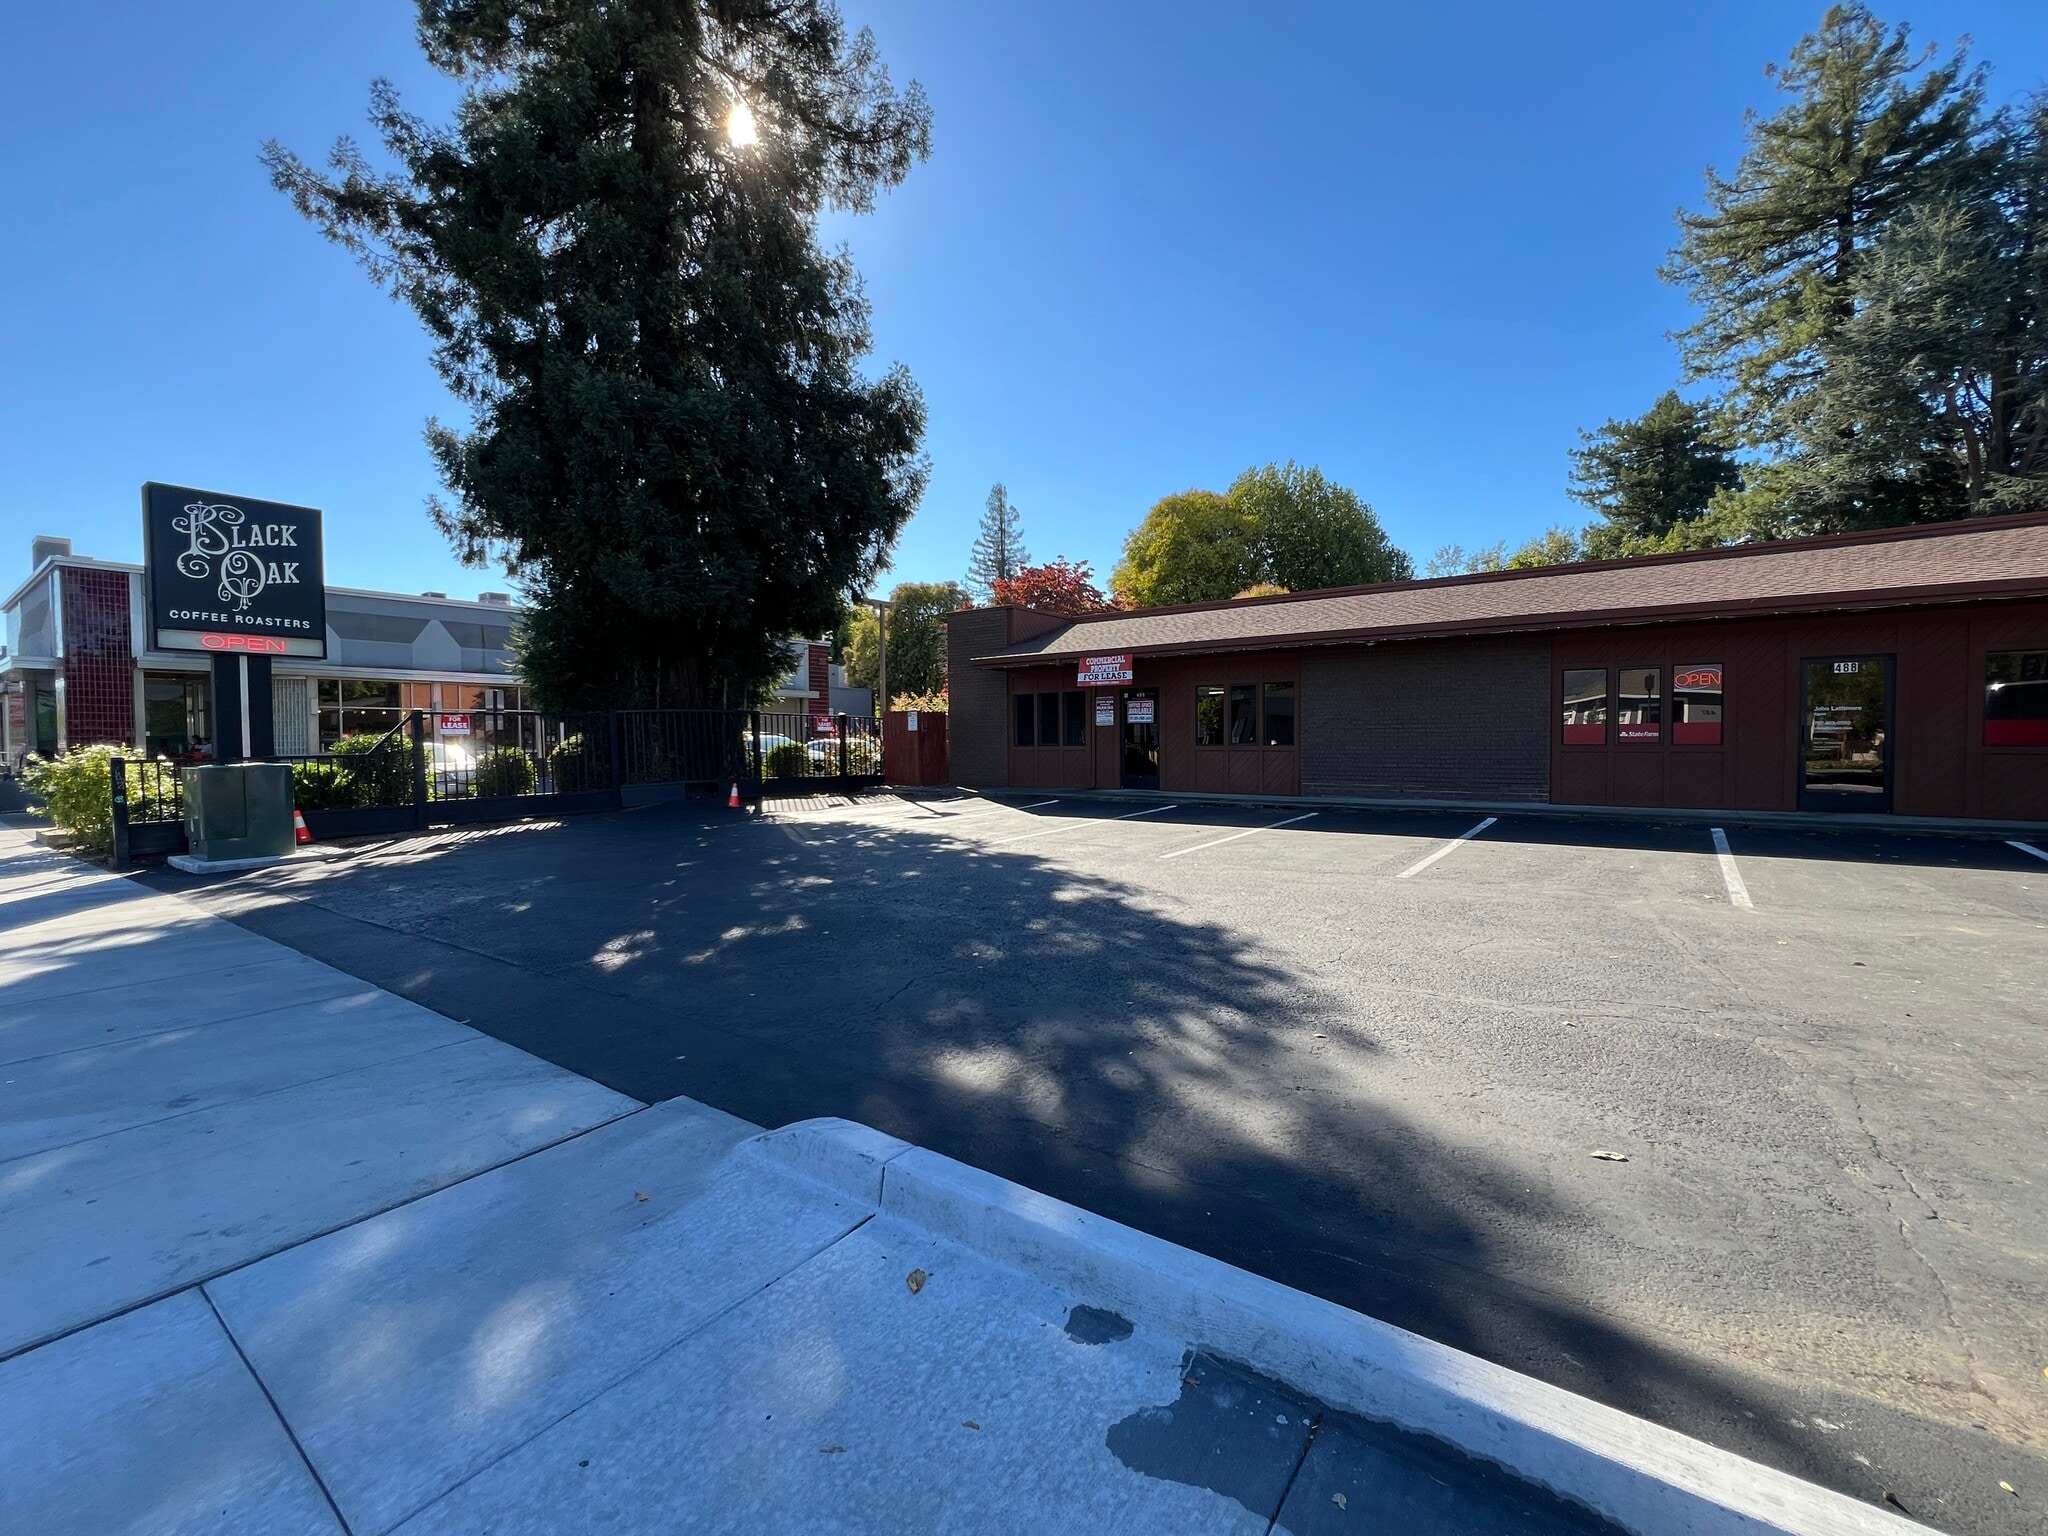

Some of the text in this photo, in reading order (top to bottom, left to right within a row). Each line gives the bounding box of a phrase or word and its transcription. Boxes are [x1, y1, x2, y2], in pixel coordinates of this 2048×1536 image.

[172, 501, 298, 579] BLACK
[218, 551, 300, 612] OAK
[169, 609, 311, 629] COFFEE ROASTERS
[202, 634, 285, 652] OPEN
[1086, 656, 1125, 665] COMMERCIAL
[1835, 664, 1857, 672] 488
[1091, 664, 1120, 673] PROPERTY
[1675, 673, 1721, 686] OPEN
